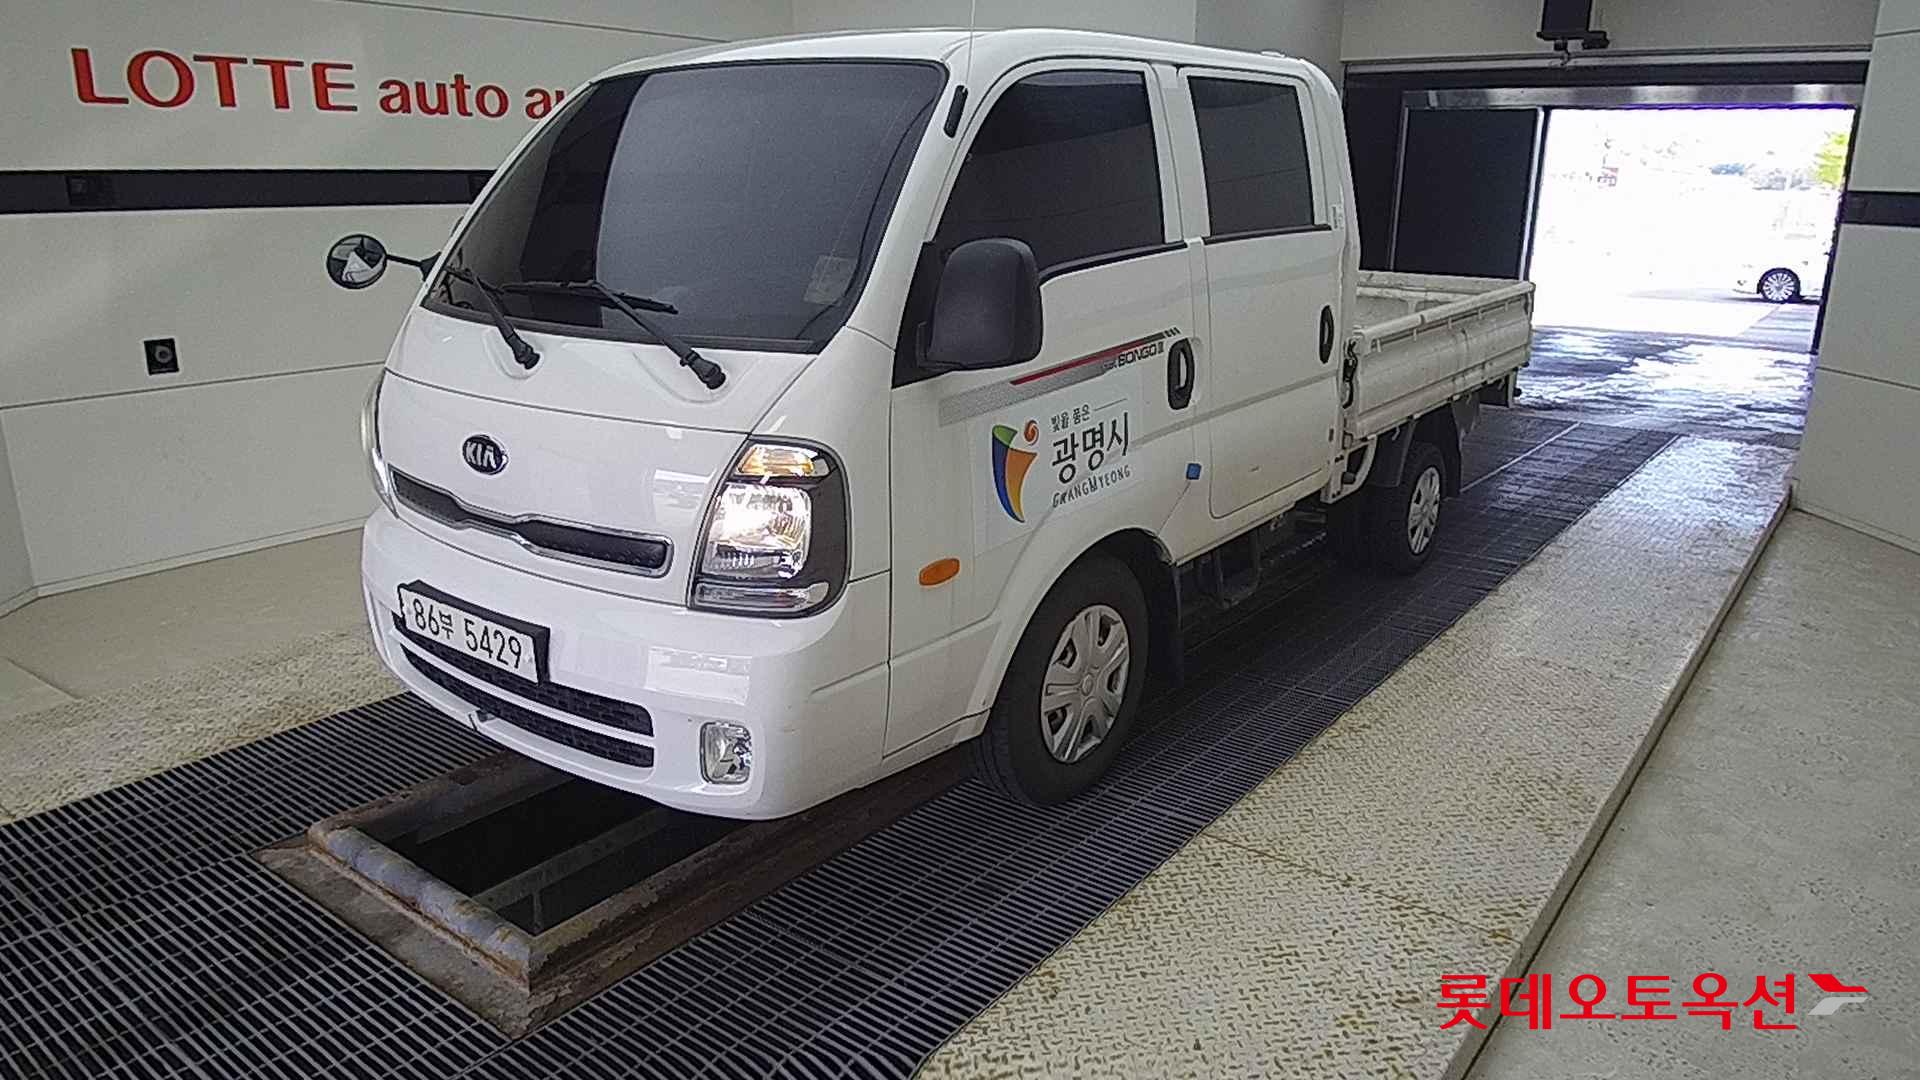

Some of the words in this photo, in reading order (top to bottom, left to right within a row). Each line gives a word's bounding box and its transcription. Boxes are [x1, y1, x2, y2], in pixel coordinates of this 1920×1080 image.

[71, 48, 358, 112] LOTTE
[378, 74, 509, 118] auto
[1051, 411, 1070, 432] 빛을
[1073, 404, 1090, 425] 품은
[1052, 411, 1129, 484] 광명시
[465, 440, 498, 469] KIA
[413, 598, 454, 640] 86부
[464, 617, 522, 669] 5429
